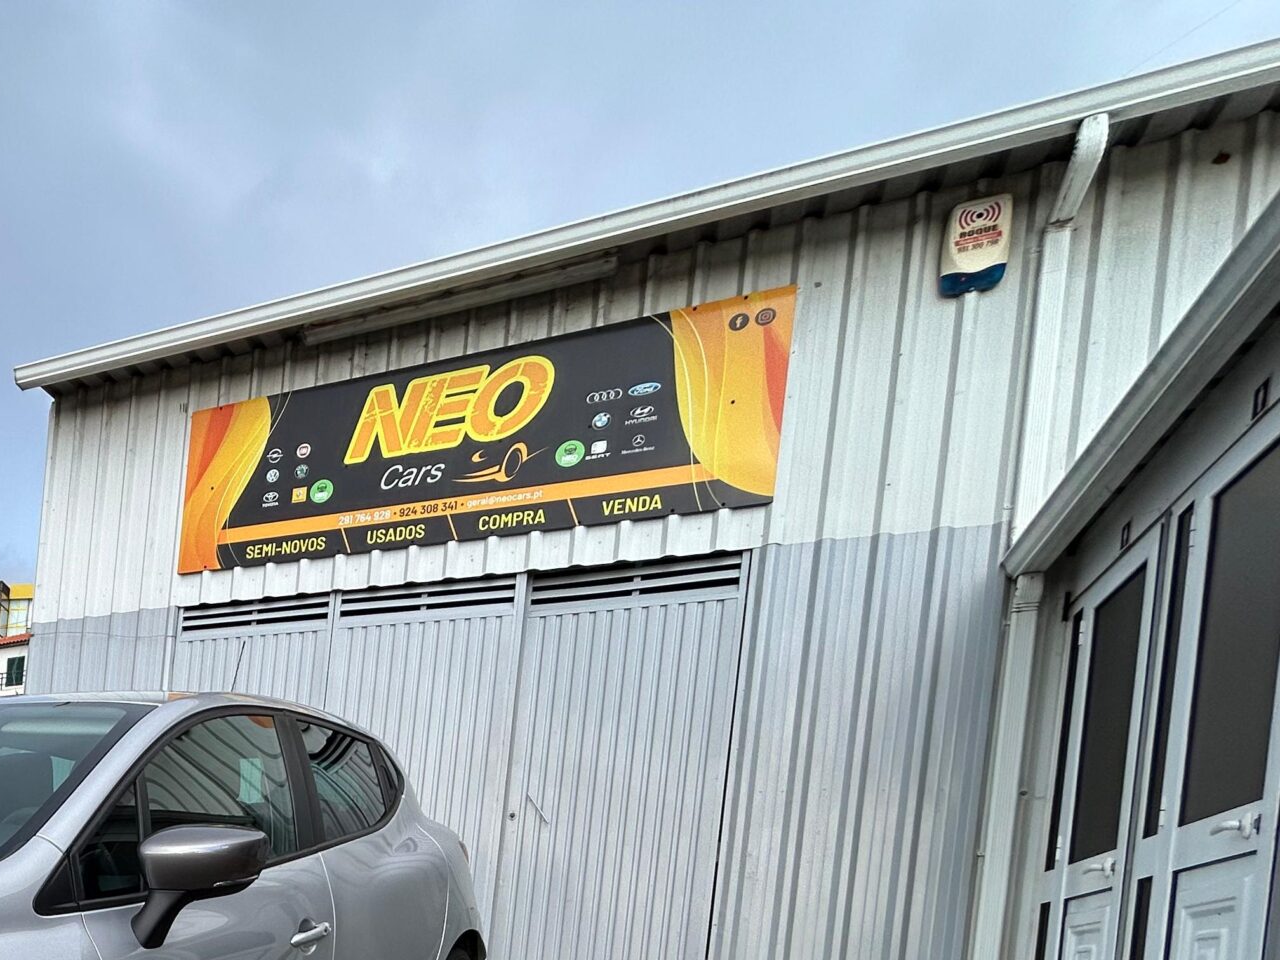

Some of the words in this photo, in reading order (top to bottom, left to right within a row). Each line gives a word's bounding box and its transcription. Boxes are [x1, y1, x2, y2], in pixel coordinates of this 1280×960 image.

[344, 355, 555, 464] NEO
[380, 462, 445, 490] Cars
[399, 506, 417, 518] 924
[420, 503, 438, 514] 308
[441, 500, 458, 512] 341
[466, 489, 543, 509] geral@neocars.pt
[602, 494, 662, 516] VENDA
[478, 509, 546, 531] COMPRA
[367, 524, 425, 545] USADOS
[245, 536, 326, 559] SEMI-NOVOS
